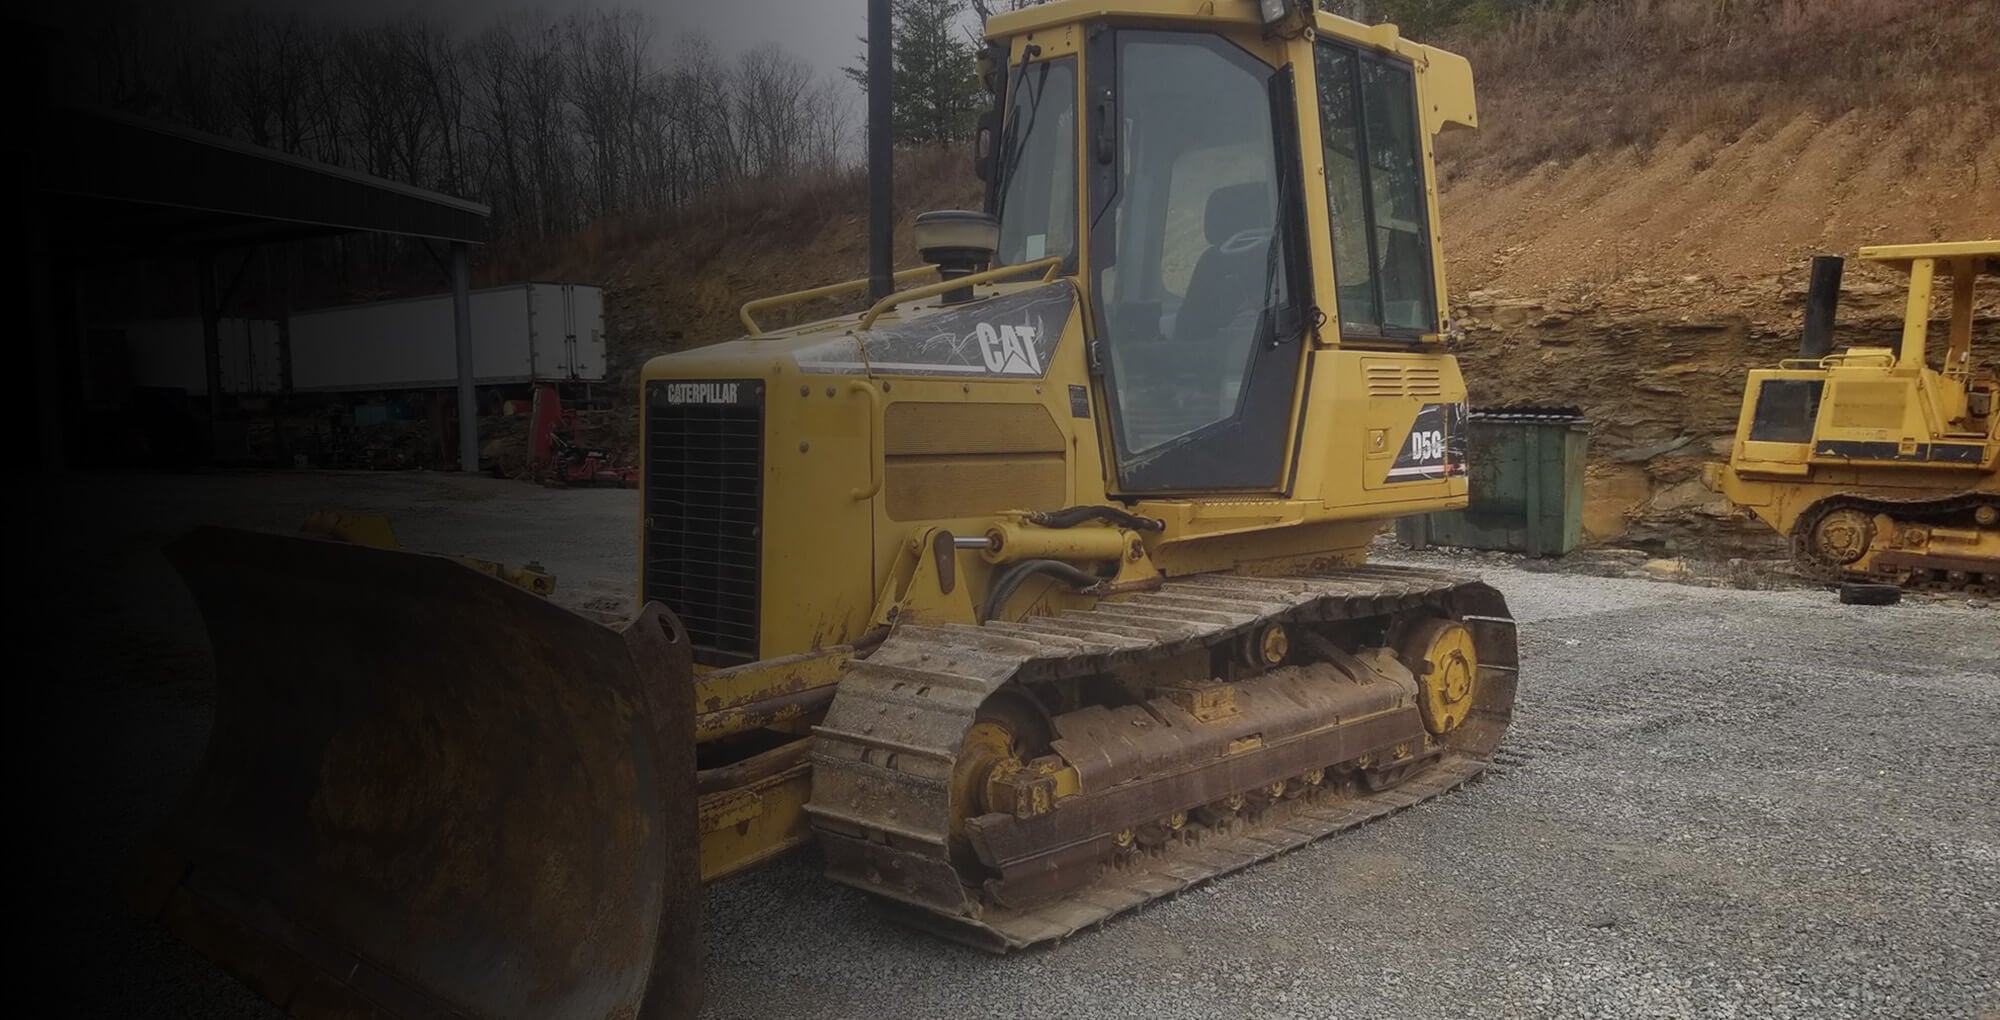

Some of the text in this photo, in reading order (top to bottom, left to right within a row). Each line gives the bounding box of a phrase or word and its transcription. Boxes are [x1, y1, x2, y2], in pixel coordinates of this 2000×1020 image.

[976, 322, 1041, 374] CAT
[667, 383, 738, 404] CATERPILLAR
[1412, 430, 1442, 460] D5G
